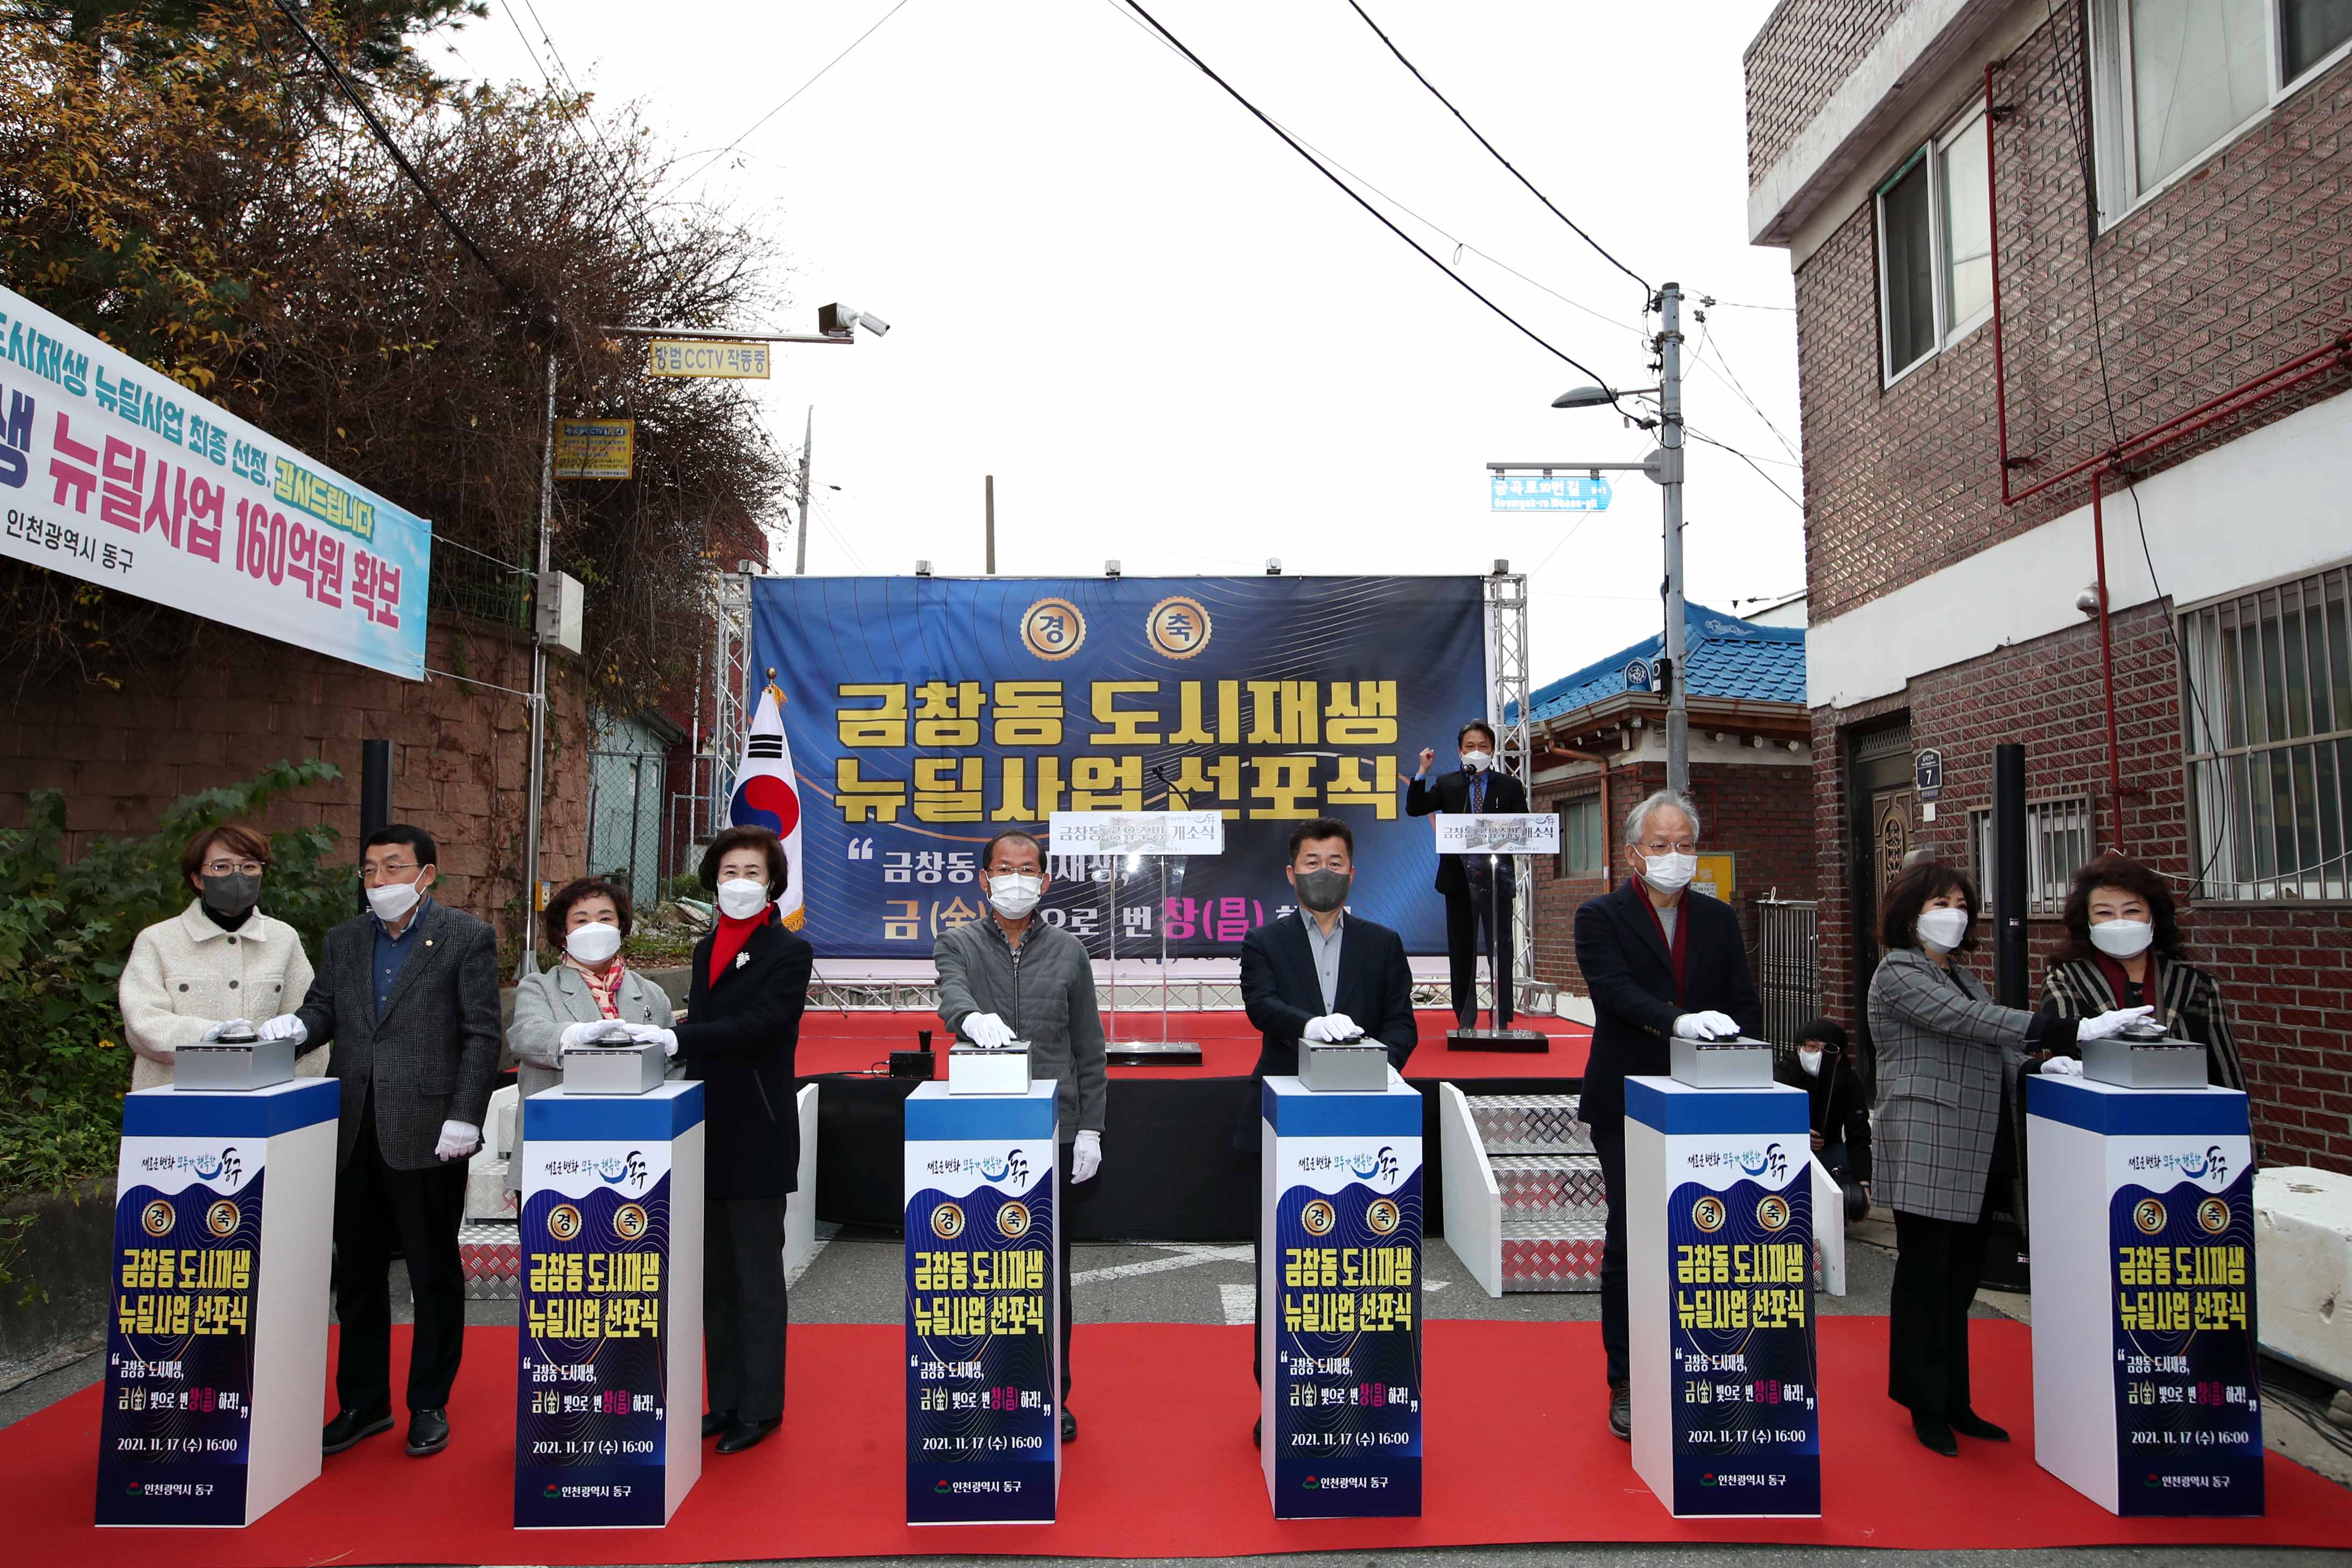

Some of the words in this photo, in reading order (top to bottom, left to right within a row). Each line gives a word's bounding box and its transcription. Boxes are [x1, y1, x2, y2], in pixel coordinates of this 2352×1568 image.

[685, 348, 724, 369] CCTV
[727, 349, 765, 373] 작동중
[95, 365, 184, 446] 뉴딜사업
[189, 415, 227, 467] 최종
[232, 439, 271, 488] 선정.
[275, 457, 374, 540] 감사드립니다
[49, 410, 226, 564] 뉴딜사업
[235, 496, 345, 610] 160억원
[352, 549, 402, 629] 확보
[6, 509, 96, 562] 인천광역시
[102, 546, 134, 574] 동구
[1039, 615, 1065, 644] 경
[1165, 613, 1193, 642] 축
[837, 681, 1065, 747] 금창동
[1090, 681, 1398, 745] 도시재생
[1926, 769, 1932, 785] 7
[836, 756, 1143, 822] 뉴딜사업
[1169, 756, 1398, 820] 선포식
[1172, 825, 1215, 839] 개소식
[1040, 908, 1100, 936] 으로
[152, 1210, 164, 1227] 경
[216, 1210, 231, 1227] 축
[558, 1214, 570, 1230] 경
[624, 1213, 638, 1230] 축
[941, 1213, 953, 1230] 경
[1007, 1211, 1020, 1228] 축
[1312, 1210, 1324, 1226] 경
[1376, 1208, 1390, 1224] 축
[1702, 1206, 1714, 1223] 경
[1766, 1205, 1780, 1221] 축
[2143, 1208, 2156, 1225] 경
[2207, 1207, 2221, 1224] 축
[122, 1249, 176, 1288] 금창동
[179, 1250, 250, 1289] 도시재생
[530, 1253, 583, 1292] 금창동
[588, 1253, 659, 1292] 도시재생
[915, 1251, 968, 1290] 금창동
[973, 1250, 1044, 1290] 도시재생
[1285, 1248, 1337, 1286] 금창동
[1342, 1248, 1412, 1286] 도시재생
[1677, 1244, 1729, 1283] 금창동
[1734, 1244, 1803, 1283] 도시재생
[2119, 1247, 2171, 1285] 금창동
[2175, 1247, 2246, 1285] 도시재생
[119, 1295, 190, 1334] 뉴딜사업
[194, 1296, 248, 1335] 선포식
[529, 1299, 600, 1338] 뉴딜사업
[605, 1299, 659, 1337] 선포식
[915, 1297, 986, 1336] 뉴딜사업
[991, 1296, 1043, 1335] 선포식
[1285, 1293, 1355, 1332] 뉴딜사업
[1360, 1292, 1411, 1332] 선포식
[1678, 1290, 1747, 1329] 뉴딜사업
[1753, 1290, 1804, 1328] 선포식
[2121, 1292, 2190, 1330] 뉴딜사업
[2195, 1291, 2246, 1330] 선포식
[149, 1361, 184, 1381] 도시재생,
[561, 1364, 597, 1383] 도시재생,
[949, 1361, 984, 1380] 도시재생,
[1318, 1357, 1353, 1377] 도시재생,
[1712, 1355, 1747, 1374] 도시재생,
[151, 1392, 174, 1409] 빛으로
[953, 1392, 976, 1409] 빛으로
[1321, 1388, 1345, 1405] 빛으로
[1716, 1385, 1740, 1402] 빛으로
[2159, 1386, 2183, 1404] 빛으로
[564, 1395, 588, 1412] 빛으로
[117, 1438, 146, 1451] 2021.
[151, 1439, 163, 1451] 11.
[168, 1439, 179, 1451] 17
[183, 1438, 202, 1452] (수)
[207, 1439, 237, 1451] 16:00
[923, 1438, 951, 1450] 2021.
[957, 1438, 968, 1450] 11.
[973, 1437, 984, 1449] 17
[988, 1436, 1007, 1450] (수)
[1012, 1437, 1042, 1448] 16:00
[1292, 1434, 1320, 1445] 2021.
[1325, 1434, 1336, 1445] 11.
[1341, 1433, 1352, 1445] 17
[1356, 1432, 1374, 1446] (수)
[1379, 1432, 1409, 1445] 16:00
[1688, 1431, 1716, 1443] 2021.
[1721, 1431, 1733, 1443] 11.
[1737, 1430, 1748, 1442] 17
[1752, 1429, 1771, 1443] (수)
[1776, 1430, 1805, 1442] 16:00
[2131, 1431, 2160, 1444] 2021.
[2164, 1432, 2176, 1444] 11.
[2181, 1432, 2191, 1444] 17
[2195, 1431, 2215, 1446] (수)
[2218, 1432, 2249, 1444] 16:00
[533, 1441, 562, 1453] 2021.
[567, 1441, 578, 1453] 11.
[583, 1441, 594, 1453] 17
[599, 1440, 618, 1454] (수)
[622, 1441, 653, 1453] 16:00
[145, 1484, 191, 1495] 인천광역시
[195, 1484, 214, 1495] 동구
[953, 1482, 999, 1493] 인천광역시
[1004, 1481, 1021, 1492] 동구
[1321, 1478, 1367, 1488] 인천광역시
[1371, 1478, 1389, 1488] 동구
[1718, 1475, 1764, 1486] 인천광역시
[1768, 1475, 1786, 1486] 동구
[2162, 1476, 2209, 1488] 인천광역시
[2212, 1476, 2230, 1488] 동구
[562, 1486, 609, 1497] 인천광역시
[613, 1486, 631, 1497] 동구
